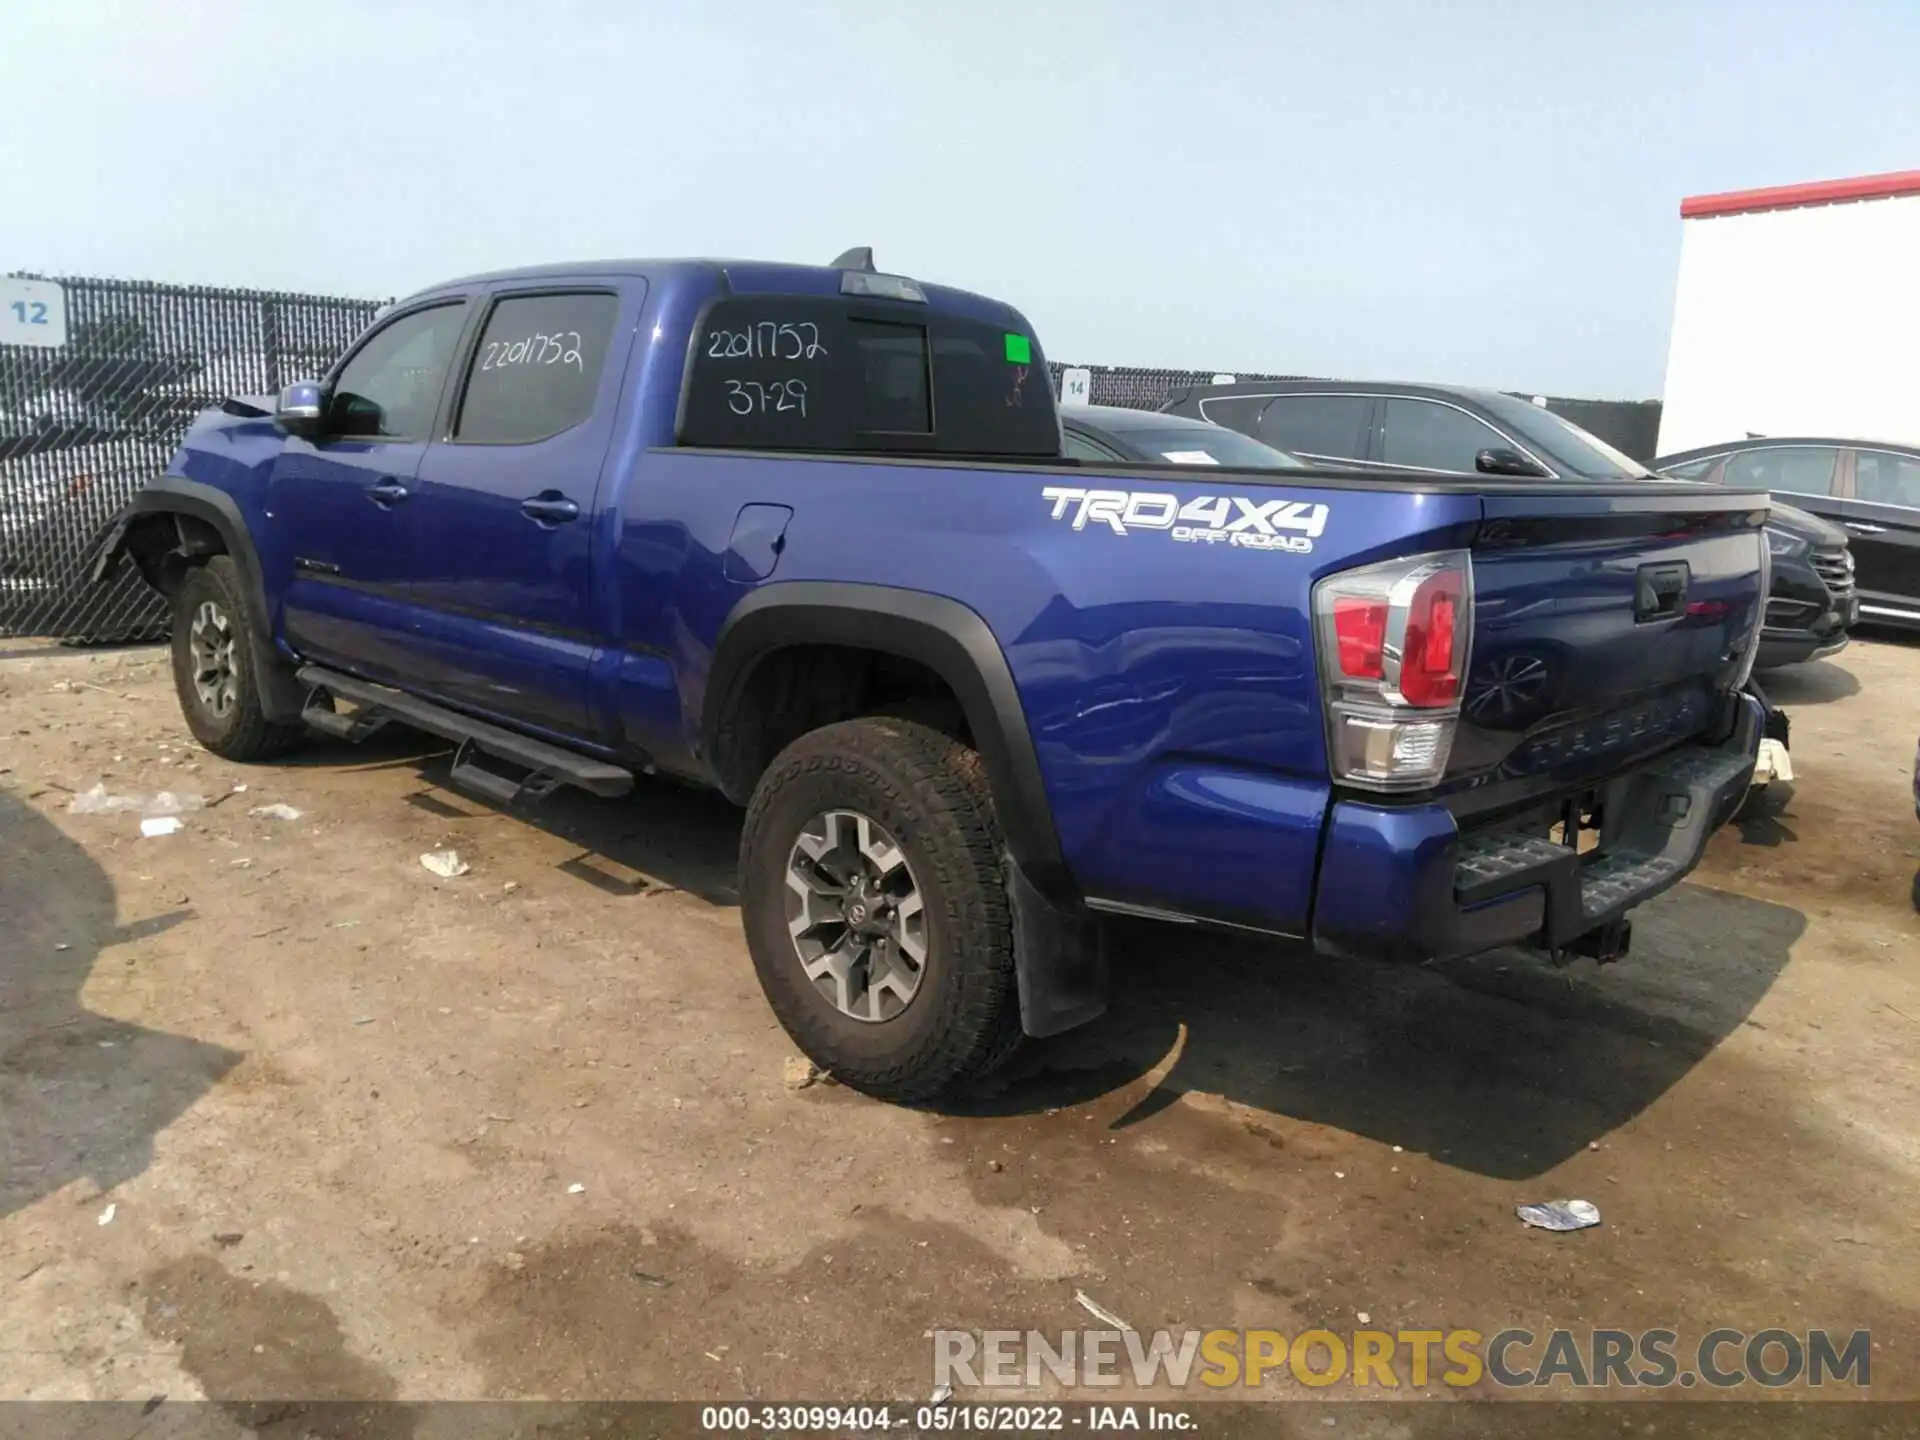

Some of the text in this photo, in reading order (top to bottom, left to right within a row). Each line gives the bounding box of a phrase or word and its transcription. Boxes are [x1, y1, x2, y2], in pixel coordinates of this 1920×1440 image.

[11, 301, 48, 325] 12
[482, 331, 583, 372] 2201752
[707, 321, 828, 360] 2201752
[1069, 380, 1084, 395] 14
[1171, 526, 1313, 553] OFF ROAD
